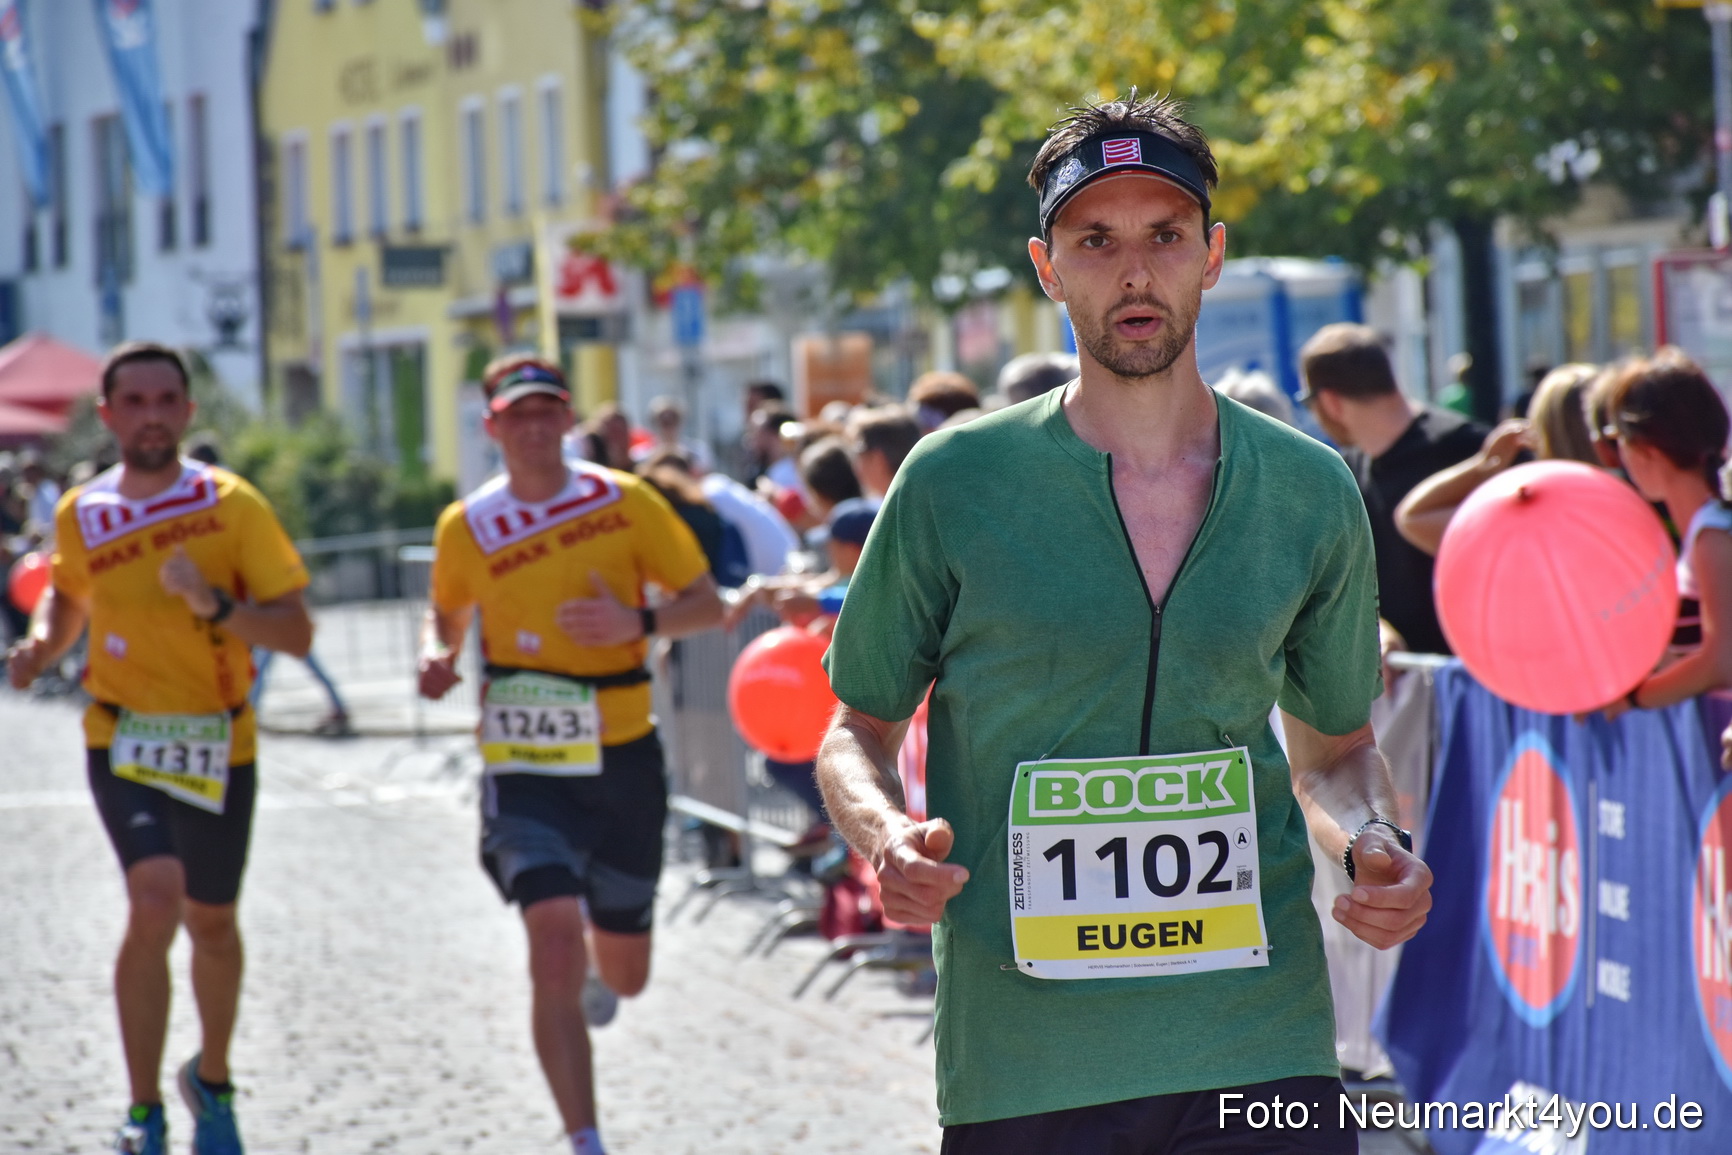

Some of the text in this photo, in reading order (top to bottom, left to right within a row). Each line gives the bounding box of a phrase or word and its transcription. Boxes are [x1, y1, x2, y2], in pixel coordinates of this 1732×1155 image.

[90, 516, 225, 574] MAX BÖGL
[490, 512, 631, 580] MAX BÖGL
[497, 709, 580, 738] 1243
[131, 740, 212, 776] 1131
[1029, 759, 1236, 818] BOCK
[1238, 832, 1247, 844] A
[1043, 830, 1232, 900] 1102
[1077, 919, 1203, 951] EUGEN
